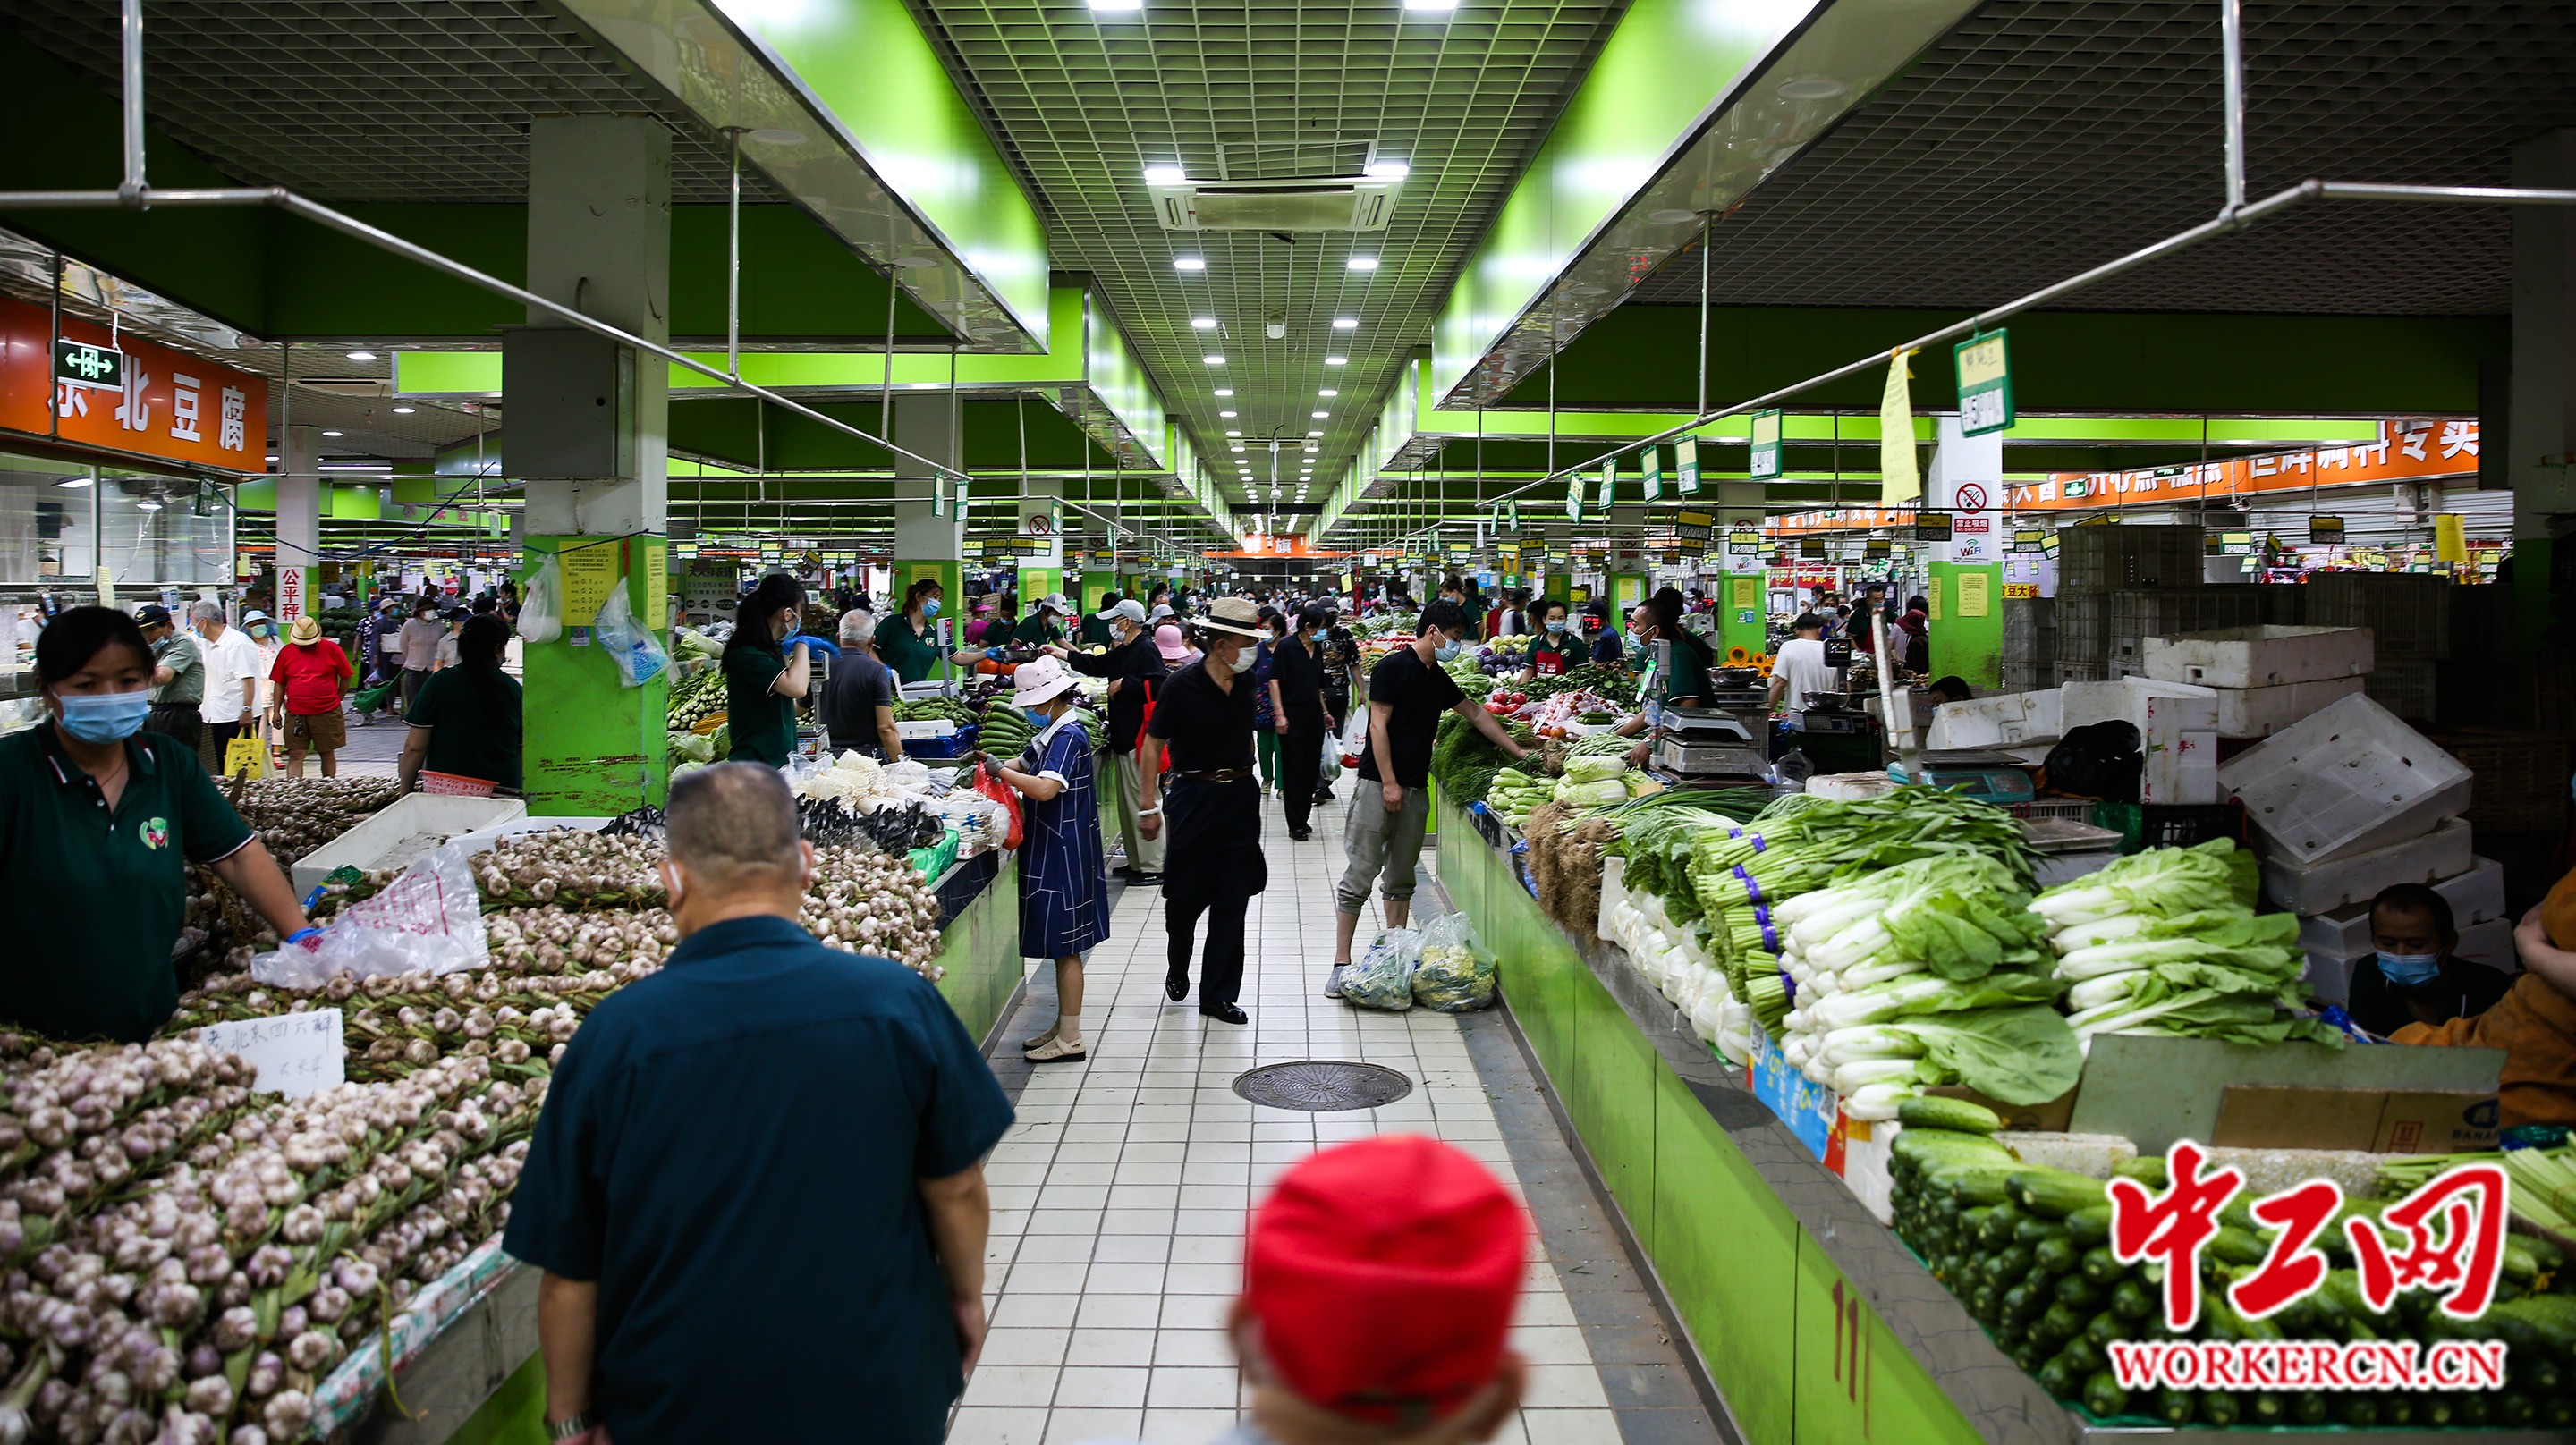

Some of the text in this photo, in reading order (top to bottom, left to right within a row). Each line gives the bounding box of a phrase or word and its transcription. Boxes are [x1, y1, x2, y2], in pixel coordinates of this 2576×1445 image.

[1956, 519, 1988, 528] 禁止吸烟
[1960, 546, 1981, 557] WiFi
[282, 569, 300, 621] 公平秤
